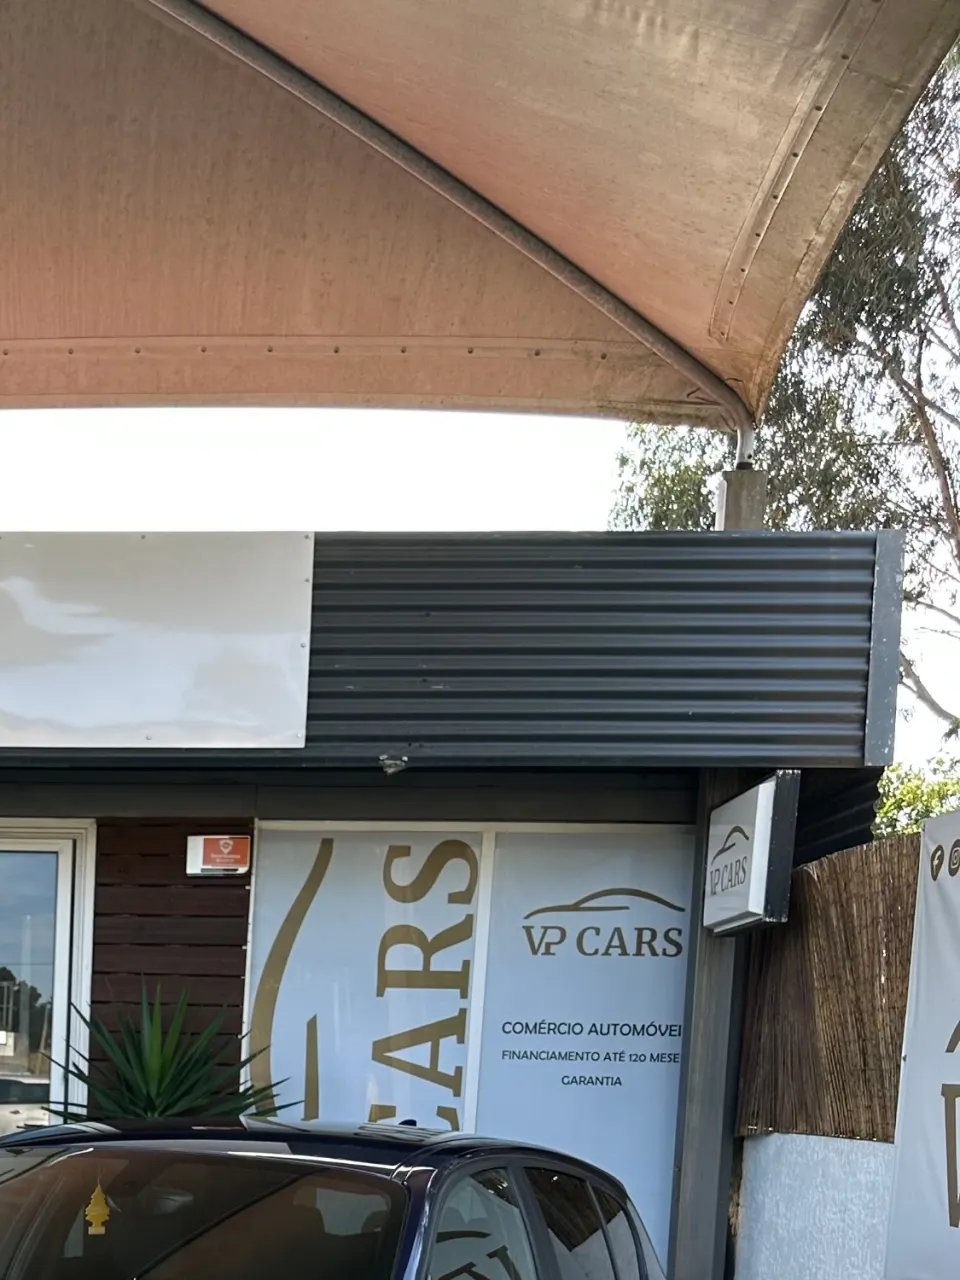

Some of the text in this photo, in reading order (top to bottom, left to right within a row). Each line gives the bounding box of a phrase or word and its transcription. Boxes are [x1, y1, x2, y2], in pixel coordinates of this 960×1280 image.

[721, 855, 748, 893] CARS
[522, 925, 684, 958] VP CARS
[501, 1019, 584, 1036] COMÉRCIO
[501, 1050, 600, 1062] FINANCIAMENTO
[603, 1050, 626, 1063] ATÉ
[628, 1053, 647, 1063] 120
[561, 1075, 622, 1087] GARANTIA
